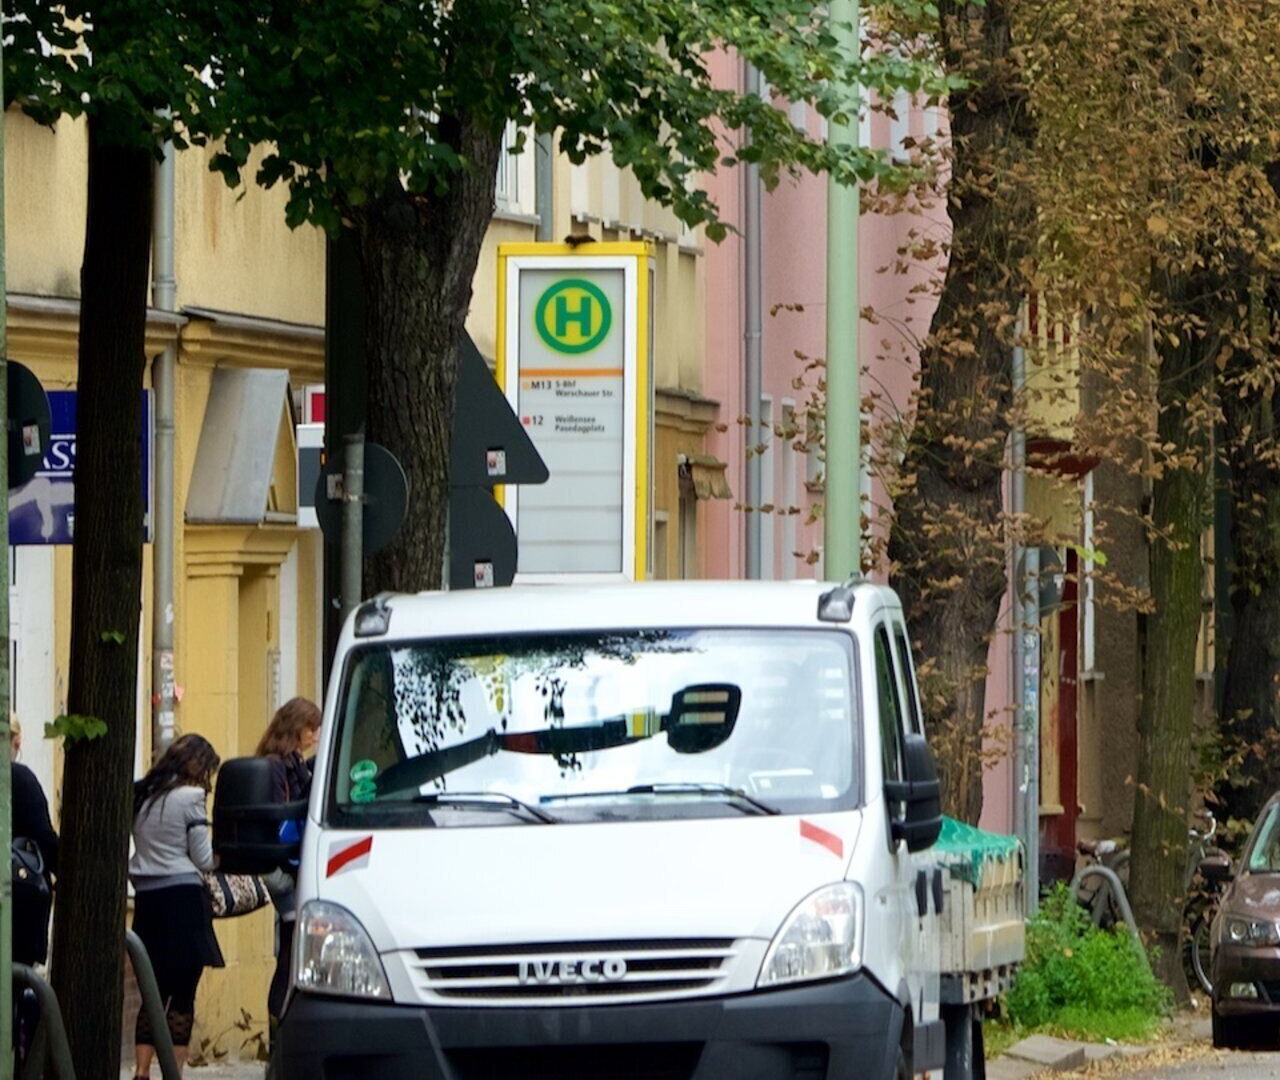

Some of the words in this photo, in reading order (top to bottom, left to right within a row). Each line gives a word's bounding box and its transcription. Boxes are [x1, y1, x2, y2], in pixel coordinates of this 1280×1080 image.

[555, 296, 591, 337] H
[531, 380, 552, 390] M13
[532, 415, 544, 425] 12
[555, 415, 596, 423] Weißensee
[519, 958, 627, 984] IVECO
